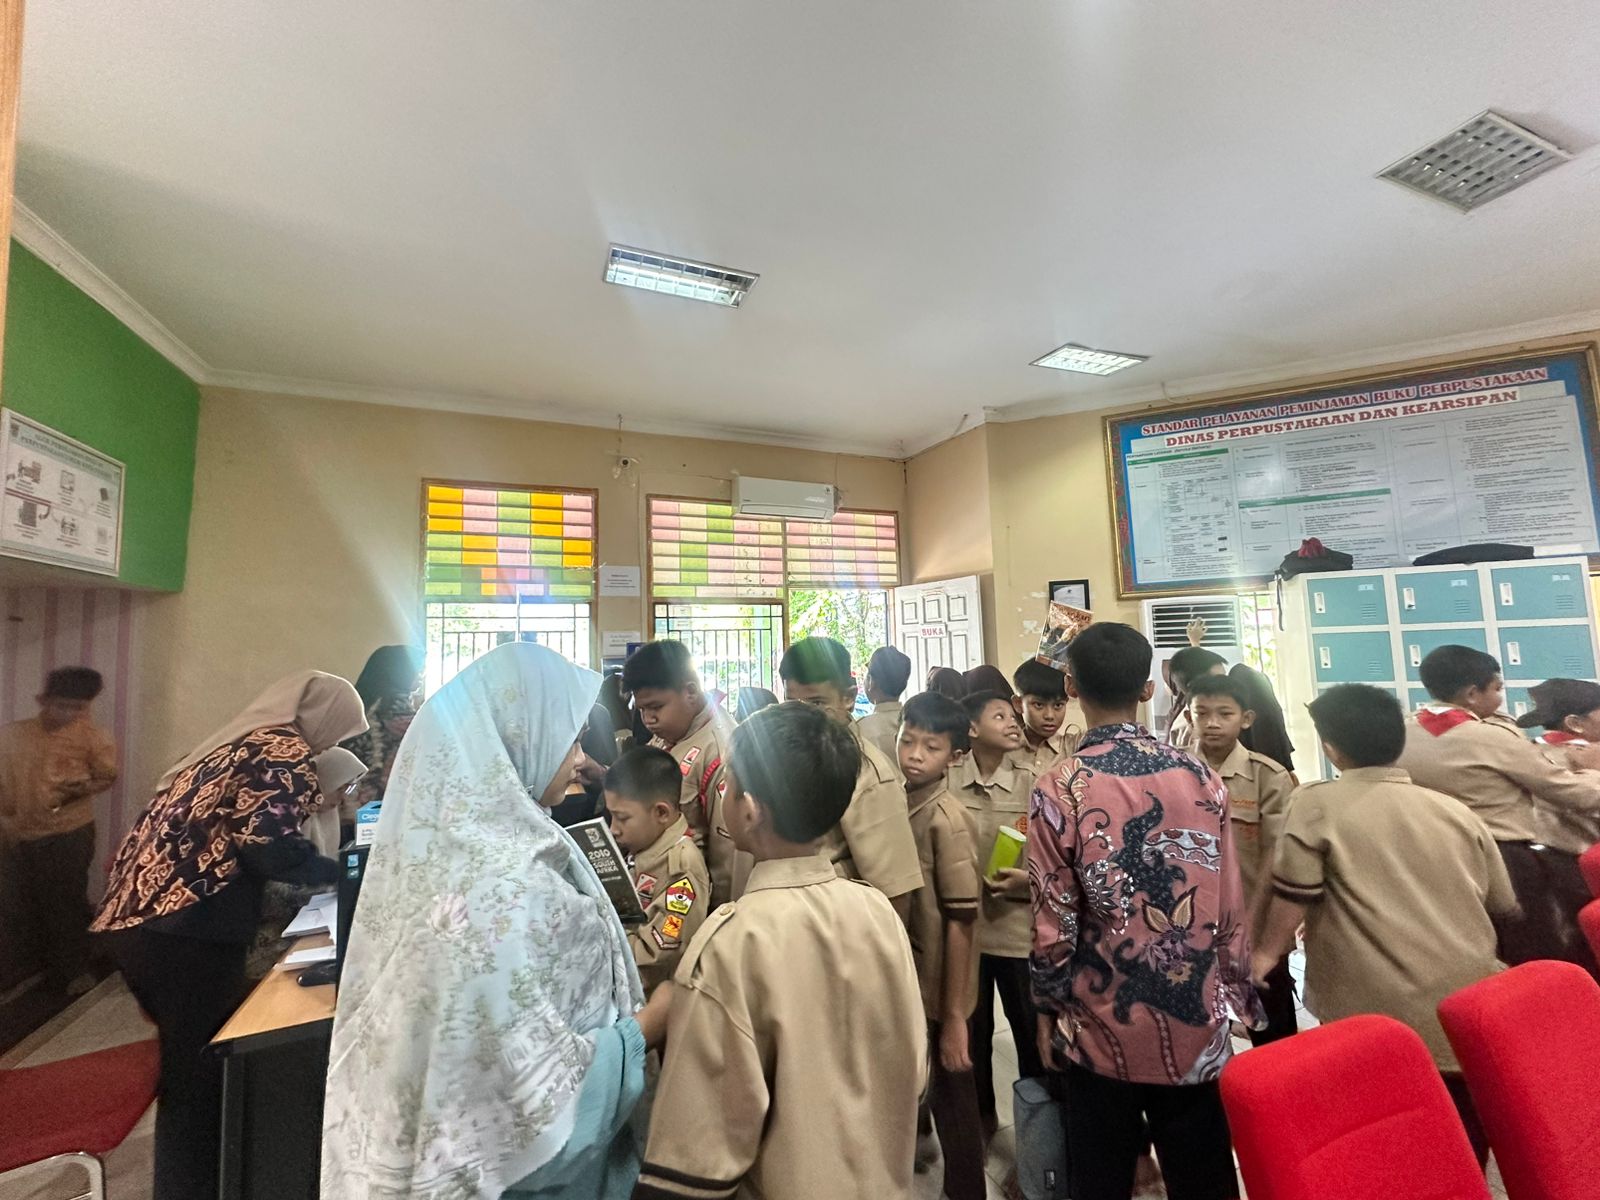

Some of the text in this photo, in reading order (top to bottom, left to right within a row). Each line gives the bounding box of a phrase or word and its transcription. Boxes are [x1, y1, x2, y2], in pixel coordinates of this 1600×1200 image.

[1142, 368, 1548, 435] STANDAR PELAYANAN PEMINJAMAN BUKU PERPUSTAKAAN
[1166, 433, 1214, 447] DINAS
[1218, 413, 1355, 440] PERPUSTAKAAN
[1359, 407, 1398, 421] DAN
[1402, 390, 1518, 415] KEARSIPAN
[921, 628, 944, 636] BUKA
[588, 849, 610, 860] 2010
